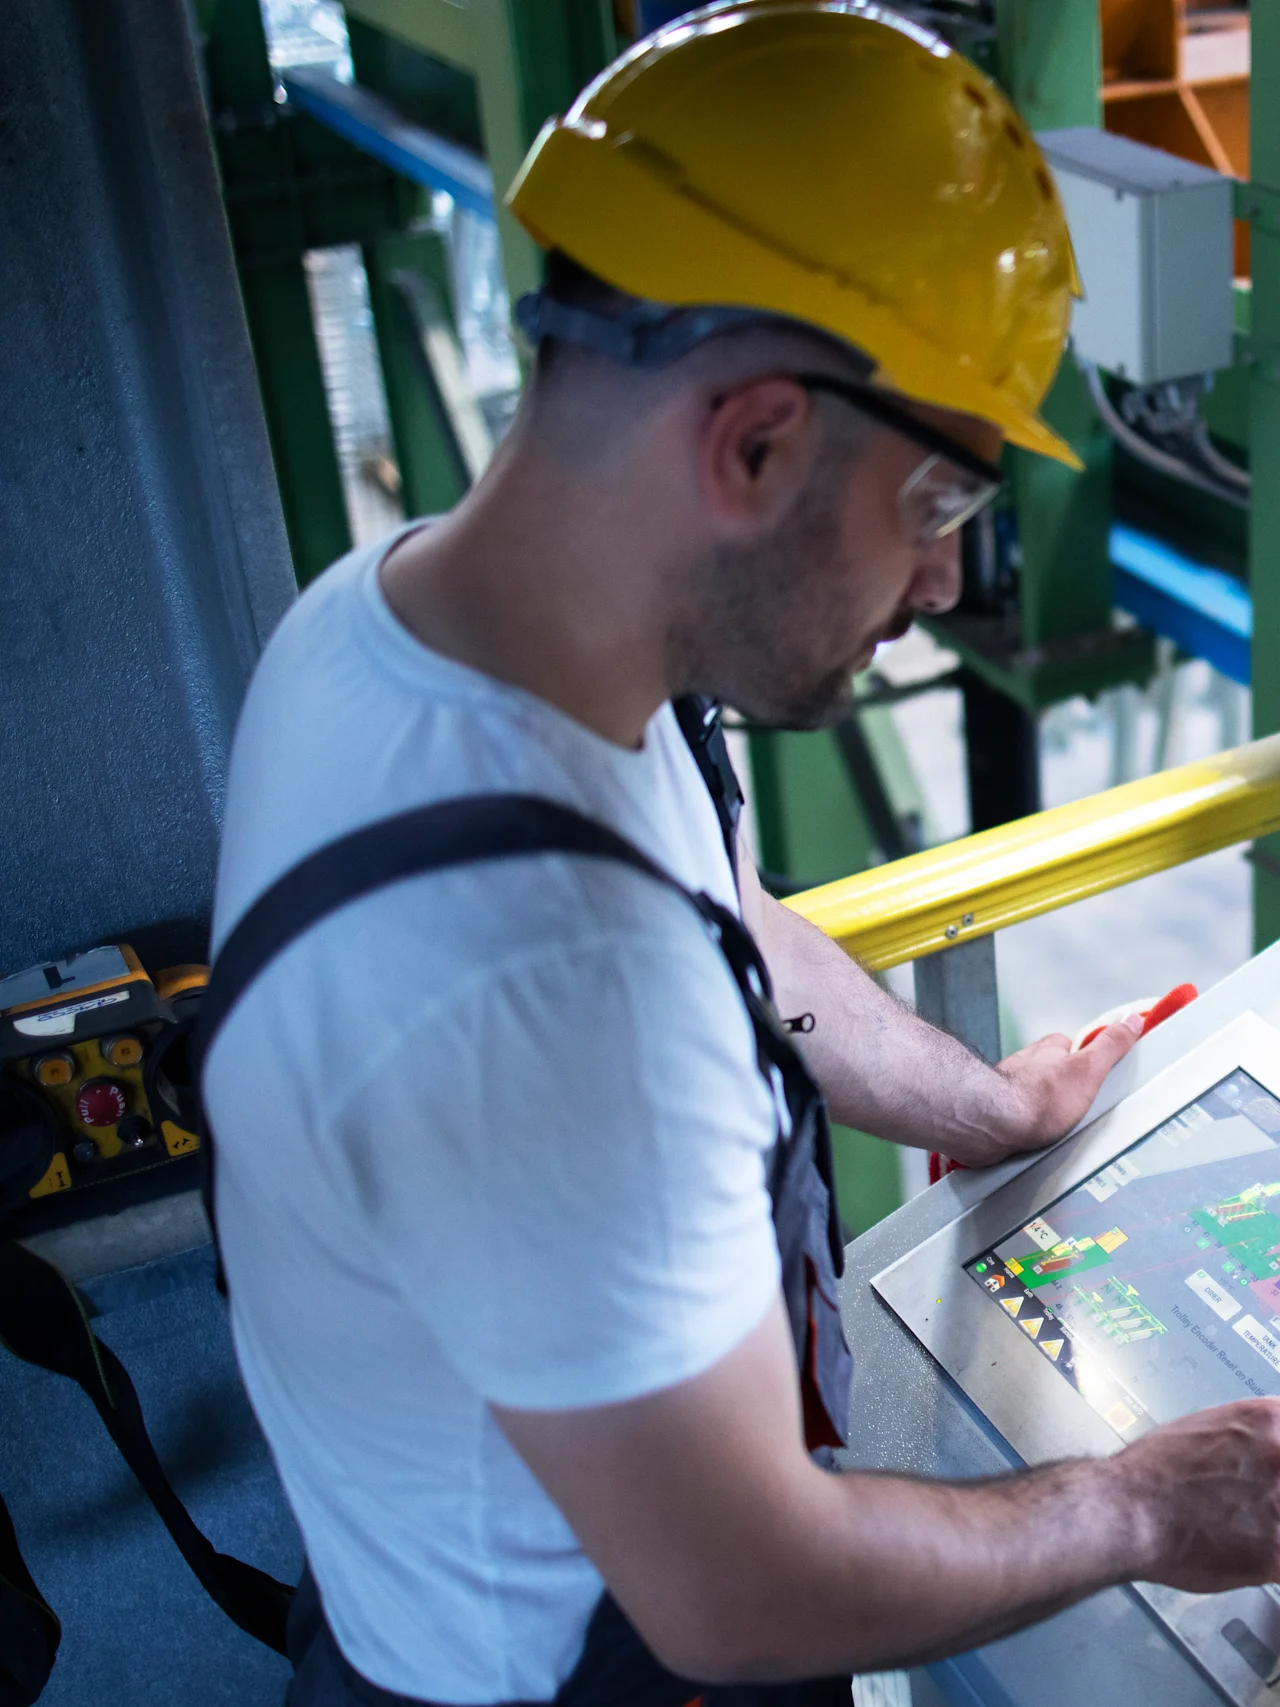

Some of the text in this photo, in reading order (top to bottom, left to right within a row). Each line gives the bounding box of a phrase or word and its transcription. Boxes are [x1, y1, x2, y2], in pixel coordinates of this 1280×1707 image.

[79, 1100, 95, 1124] Pull
[109, 1086, 126, 1118] Push
[1003, 1267, 1015, 1278] Home
[1203, 1287, 1222, 1303] DRIER
[1041, 1308, 1055, 1320] Trolley
[1167, 1305, 1193, 1328] Trolley
[1190, 1325, 1219, 1352] Encoder
[1215, 1350, 1238, 1371] Reset
[1234, 1369, 1246, 1380] on
[1242, 1330, 1280, 1366] TEMPERATURE
[1261, 1335, 1277, 1349] TANK
